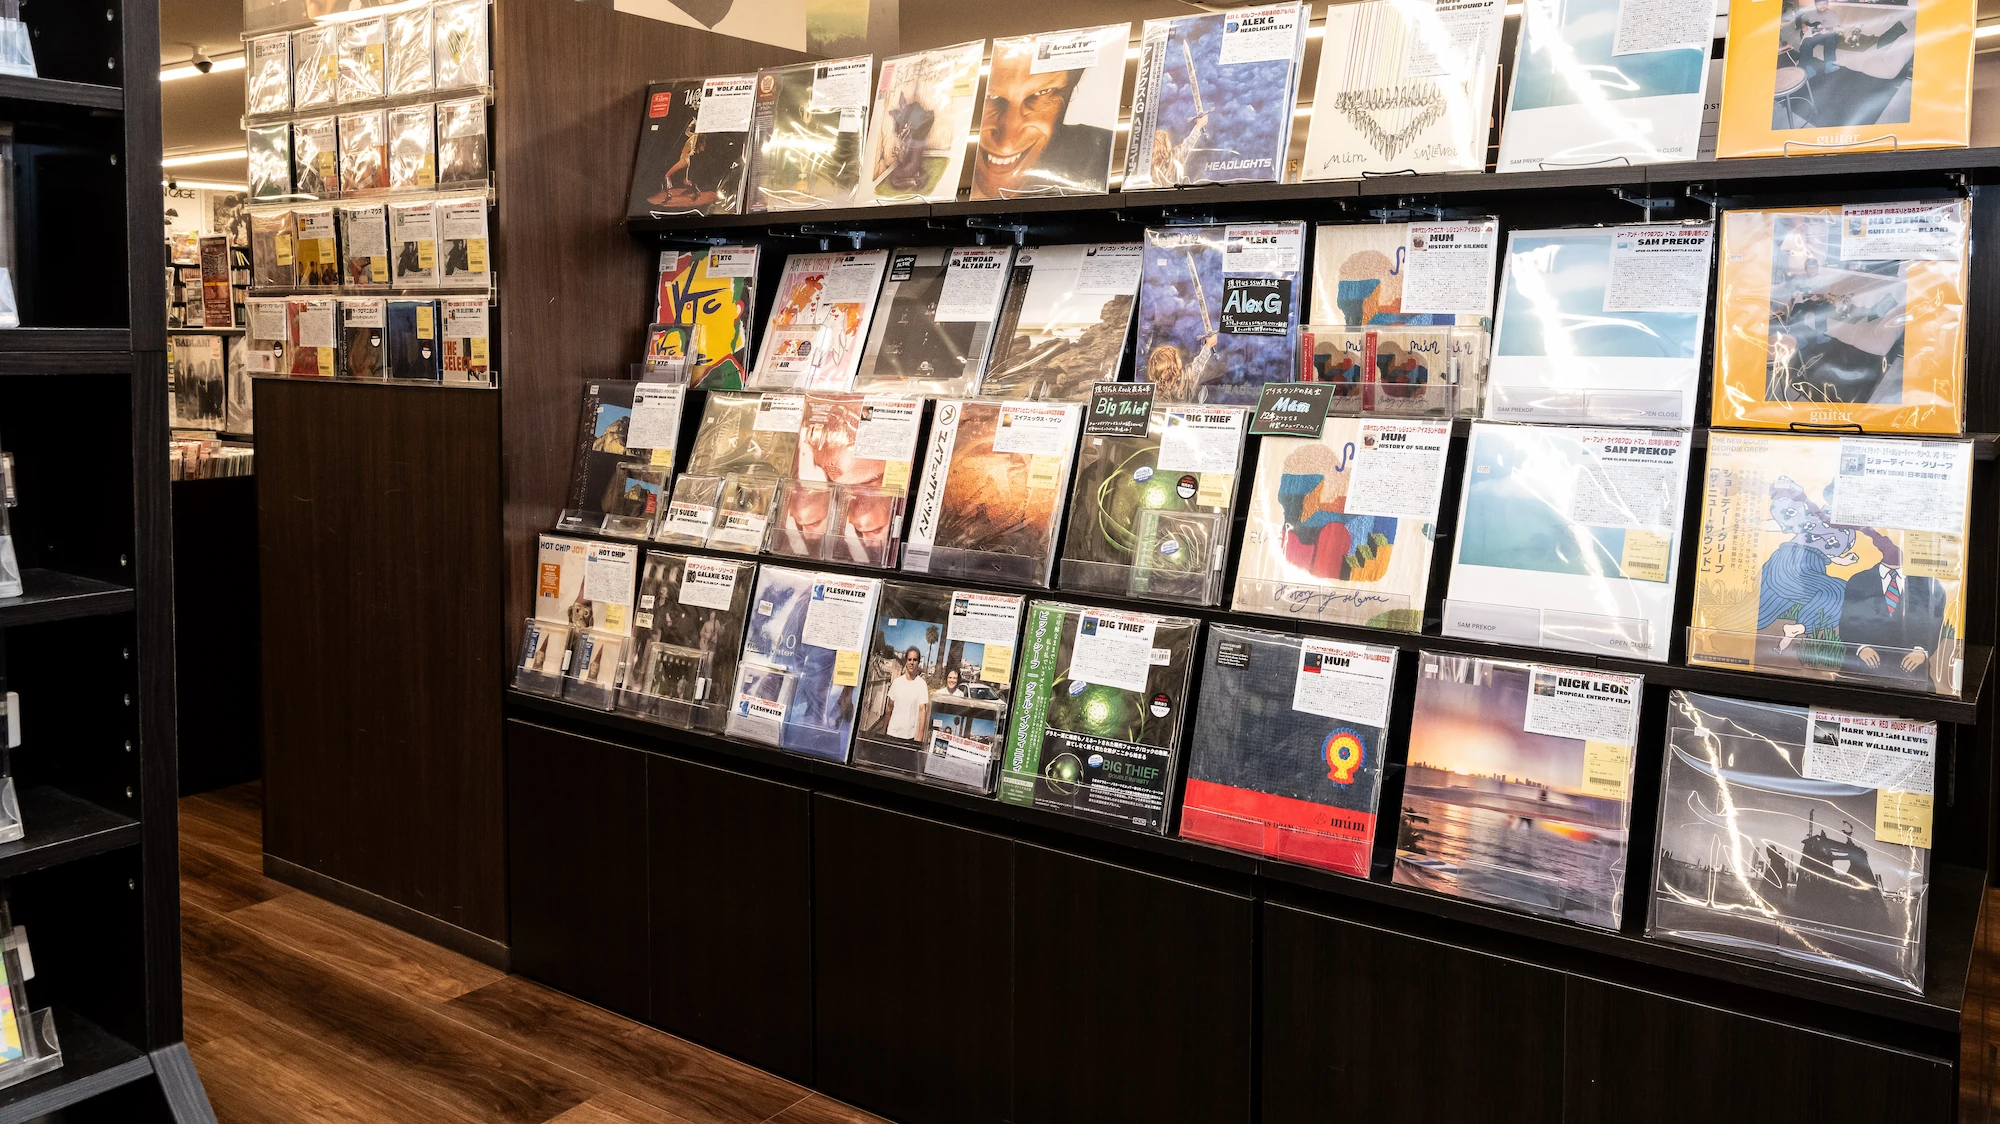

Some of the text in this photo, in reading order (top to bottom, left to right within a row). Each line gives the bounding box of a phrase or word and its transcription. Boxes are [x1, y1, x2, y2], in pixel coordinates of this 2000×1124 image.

[1241, 16, 1275, 27] ALEX G
[1240, 25, 1278, 33] HEADLIGHTS
[1816, 132, 1860, 146] guitar
[1204, 158, 1272, 171] HEADLIGHTS
[1524, 157, 1545, 165] PREKOP
[1867, 227, 1896, 235] GUITAR
[1270, 236, 1277, 244] G
[1429, 233, 1455, 242] MUM
[1637, 237, 1706, 246] SAM PREKOP
[789, 257, 831, 272] AIR THE VIRGIN
[1223, 289, 1283, 315] Alex G
[443, 341, 457, 355] THE
[1095, 397, 1149, 418] Big Thief
[1013, 415, 1062, 424] エイフェックス・ツイン
[1185, 414, 1232, 424] BIG THIEF
[1809, 408, 1853, 423] guitar
[1380, 432, 1407, 441] MUM
[1711, 436, 1726, 444] THE
[1604, 445, 1677, 456] SAM PREKOP
[1710, 444, 1743, 453] GEORDIE
[919, 430, 948, 538] エイフェックス・ツイン
[679, 508, 699, 518] SUEDE
[728, 516, 750, 526] SUEDE
[1714, 469, 1733, 574] ジョーディー・グリープ
[540, 541, 585, 555] HOT CHIP JOY
[598, 549, 626, 559] HOT CHIP
[697, 570, 733, 581] GALAXIE 500
[825, 586, 866, 599] FLESHWATER
[1098, 619, 1145, 634] BIG THIEF
[1457, 621, 1497, 631] SAM PREKOP
[1030, 611, 1050, 670] ビッグ・シーフ
[1609, 638, 1628, 647] OPEN
[1324, 656, 1350, 668] MUM
[1558, 677, 1629, 696] NICK LEON
[1556, 689, 1586, 699] TROPICAL
[1586, 694, 1614, 703] ENTROPY
[750, 703, 782, 717] FLESHWATER
[1012, 681, 1037, 773] ダブル・インフィニティ
[1879, 720, 1889, 729] RED
[1890, 722, 1907, 732] HOUSE
[1841, 726, 1929, 745] MARK WILLIAM LEWIS
[1840, 738, 1929, 757] MARK WILLIAM LEWIS
[1101, 759, 1160, 780] BIG THIEF
[1108, 772, 1128, 782] DOUBLE
[1330, 815, 1366, 832] múm
